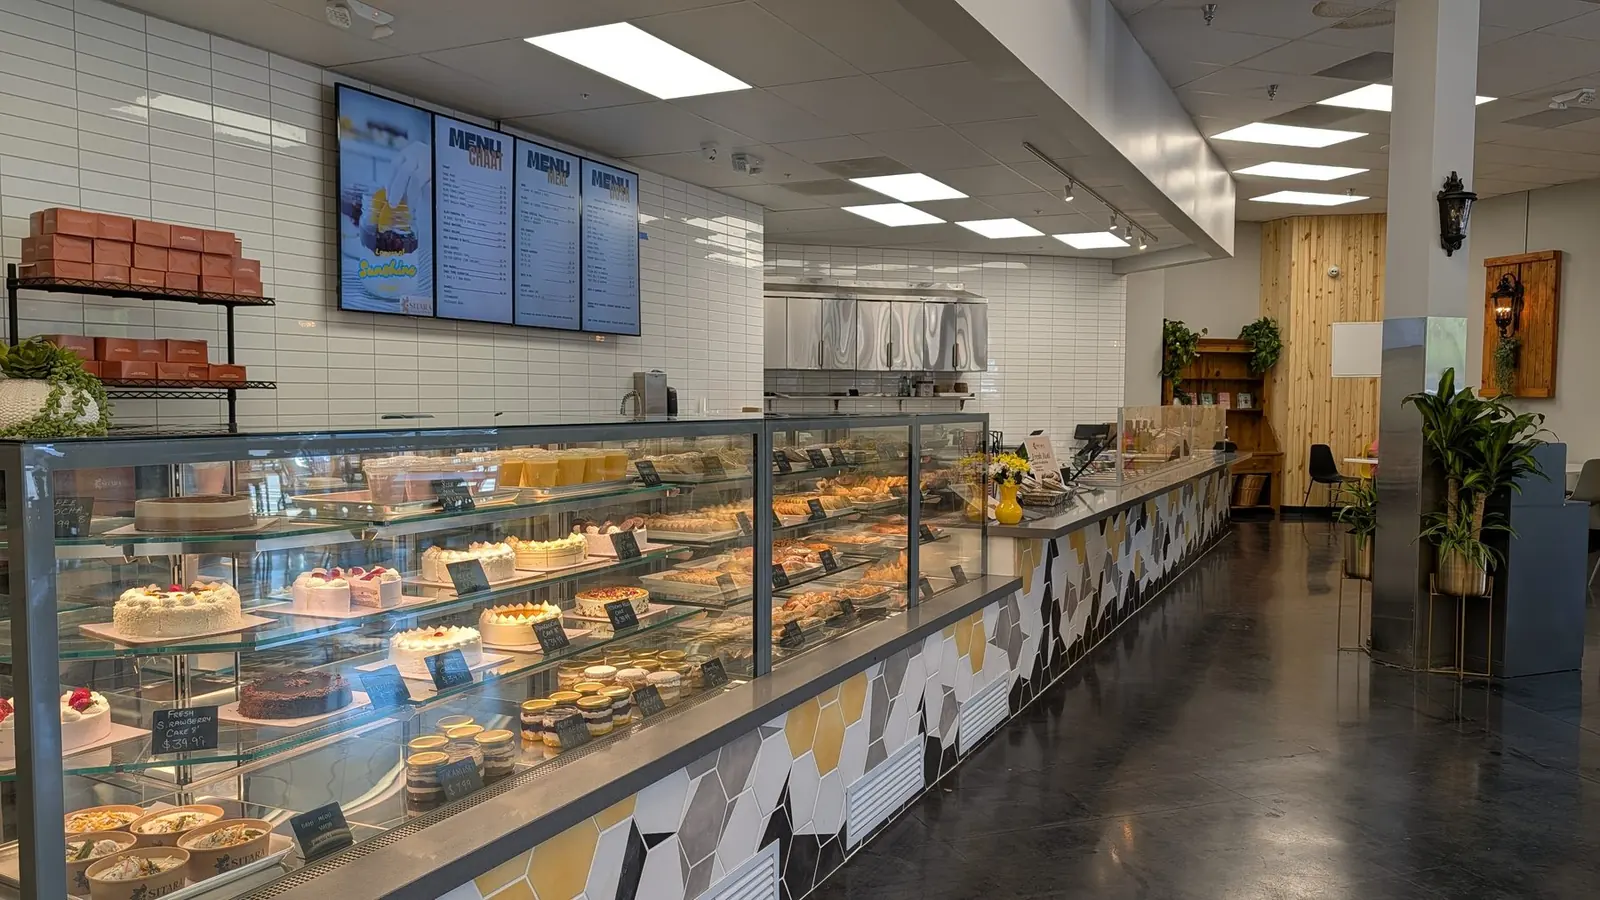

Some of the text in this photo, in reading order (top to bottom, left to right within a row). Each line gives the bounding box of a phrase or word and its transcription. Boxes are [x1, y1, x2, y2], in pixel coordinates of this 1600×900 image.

[449, 127, 501, 153] MENU
[527, 150, 570, 178] MENU
[592, 169, 629, 190] MENU
[359, 259, 417, 278] Sunshine
[156, 716, 211, 730] SRAWBERRY
[168, 710, 194, 719] FRESH
[166, 728, 189, 738] CAKE
[162, 735, 205, 751] $39.99
[232, 848, 266, 867] SITARA
[147, 877, 185, 899] SITARA
